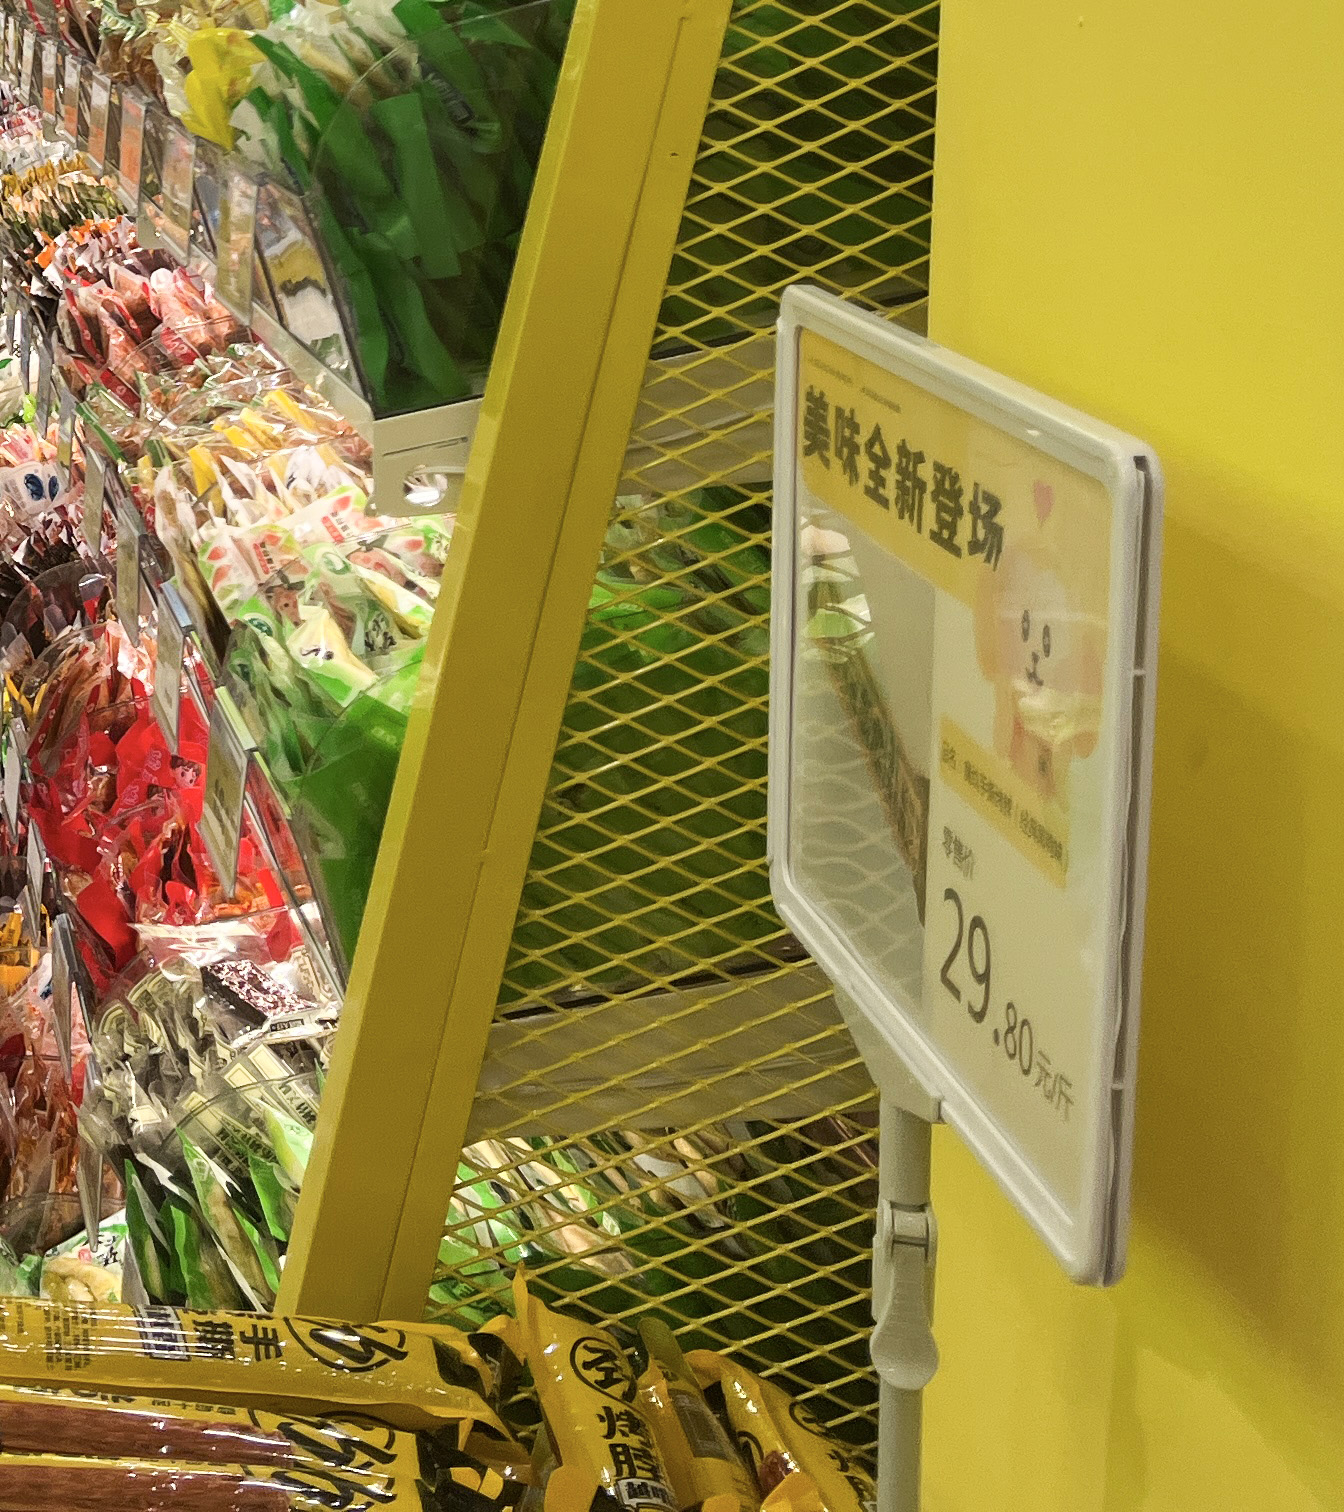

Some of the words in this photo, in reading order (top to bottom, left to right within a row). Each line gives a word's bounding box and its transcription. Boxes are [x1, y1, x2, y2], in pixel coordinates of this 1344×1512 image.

[802, 384, 1005, 573] 美味全新登场
